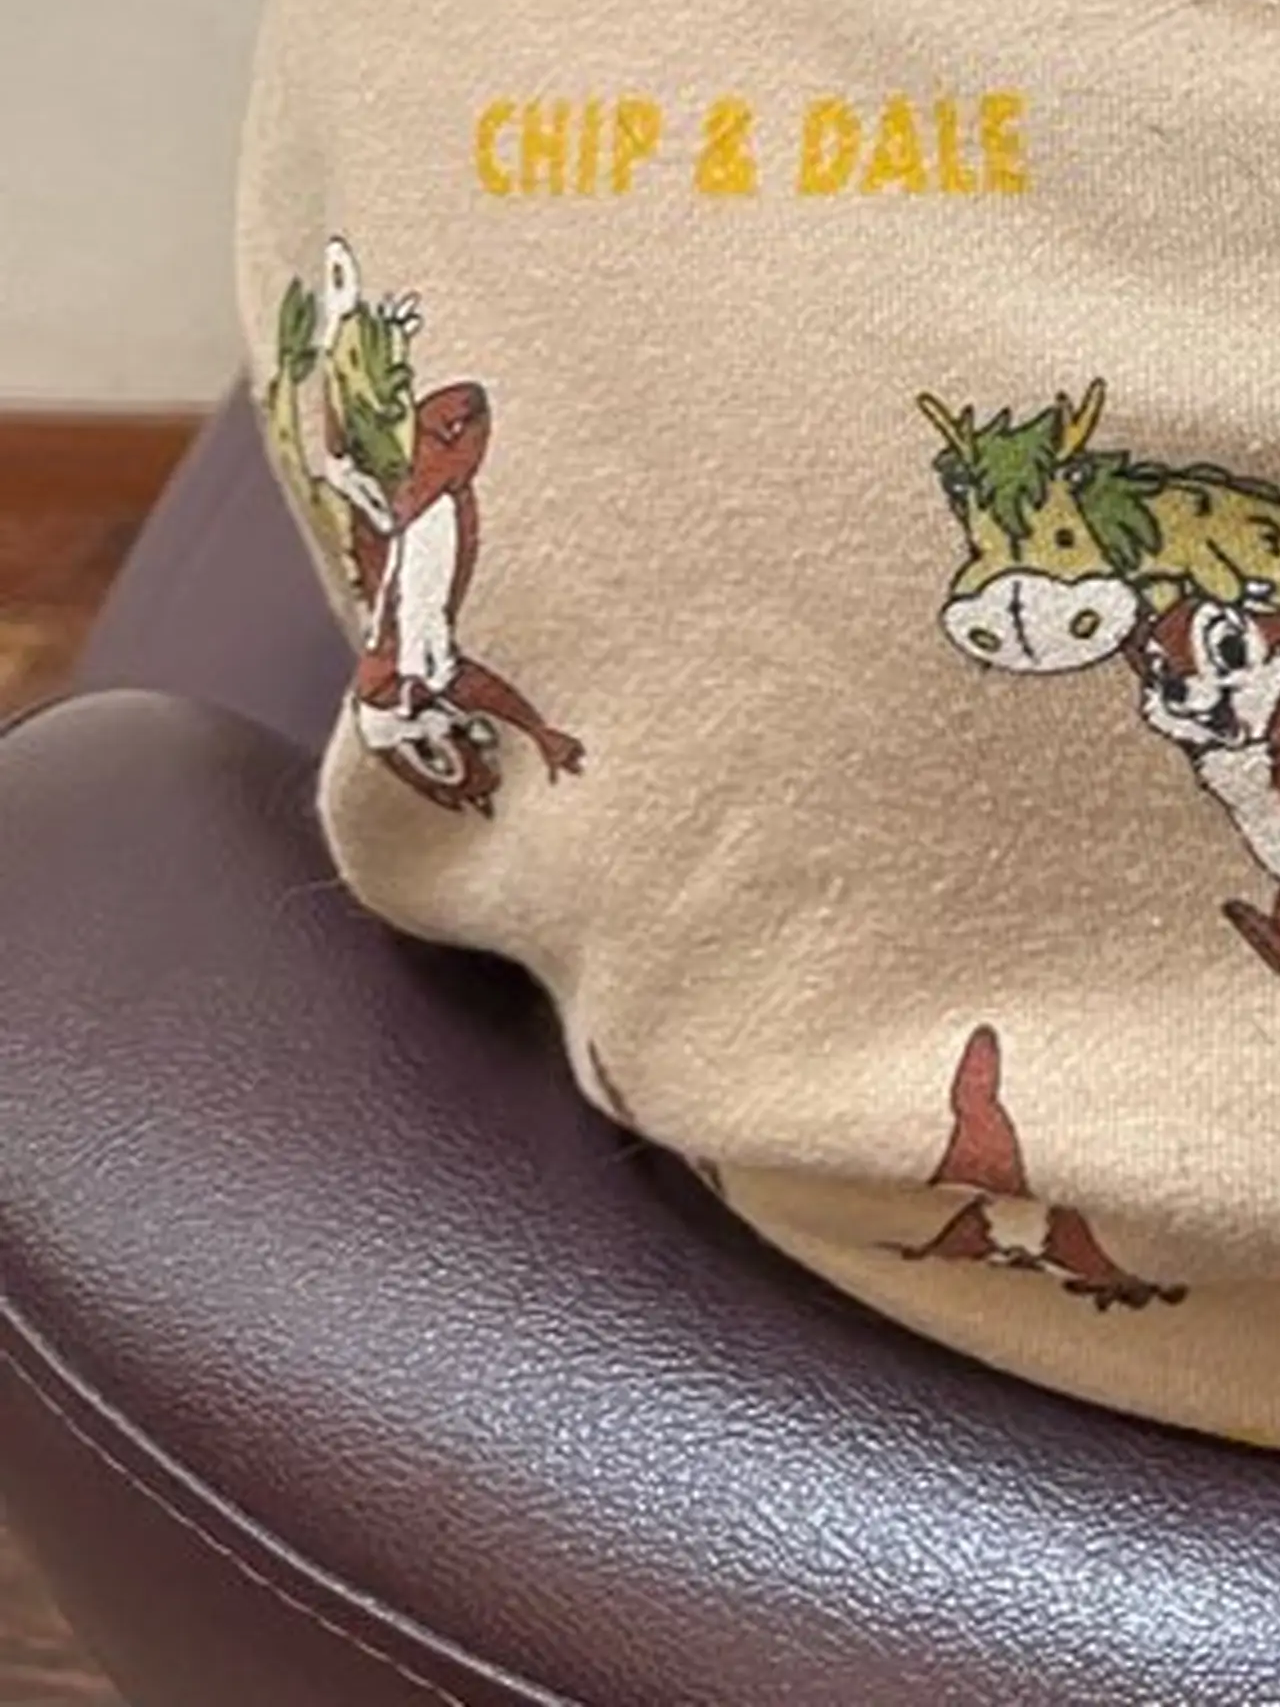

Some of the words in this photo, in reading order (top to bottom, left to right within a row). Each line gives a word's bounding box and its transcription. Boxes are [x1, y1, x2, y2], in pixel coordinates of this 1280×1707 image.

[475, 98, 663, 197] CHIP
[694, 94, 757, 196] &
[797, 87, 1032, 197] DALE
